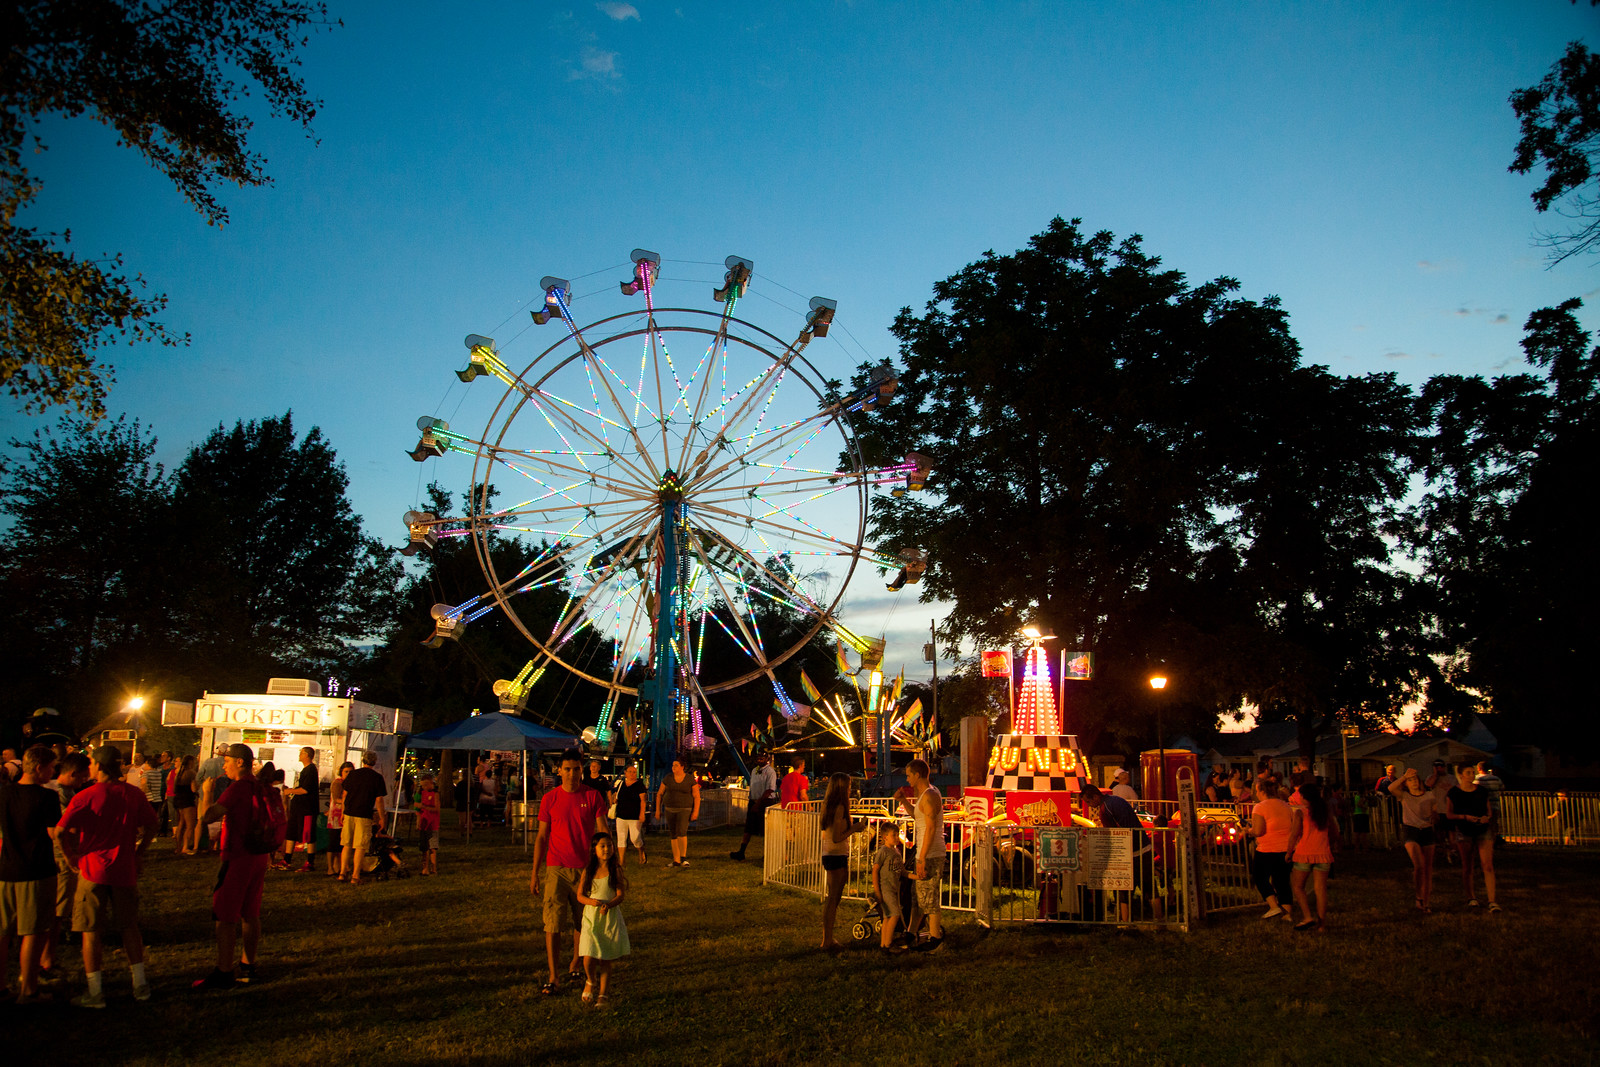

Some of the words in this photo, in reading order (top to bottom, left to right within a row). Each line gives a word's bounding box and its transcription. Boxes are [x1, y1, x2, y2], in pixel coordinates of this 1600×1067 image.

[201, 703, 319, 726] TICKETS
[1026, 799, 1058, 816] JUMP
[1055, 839, 1063, 855] 3
